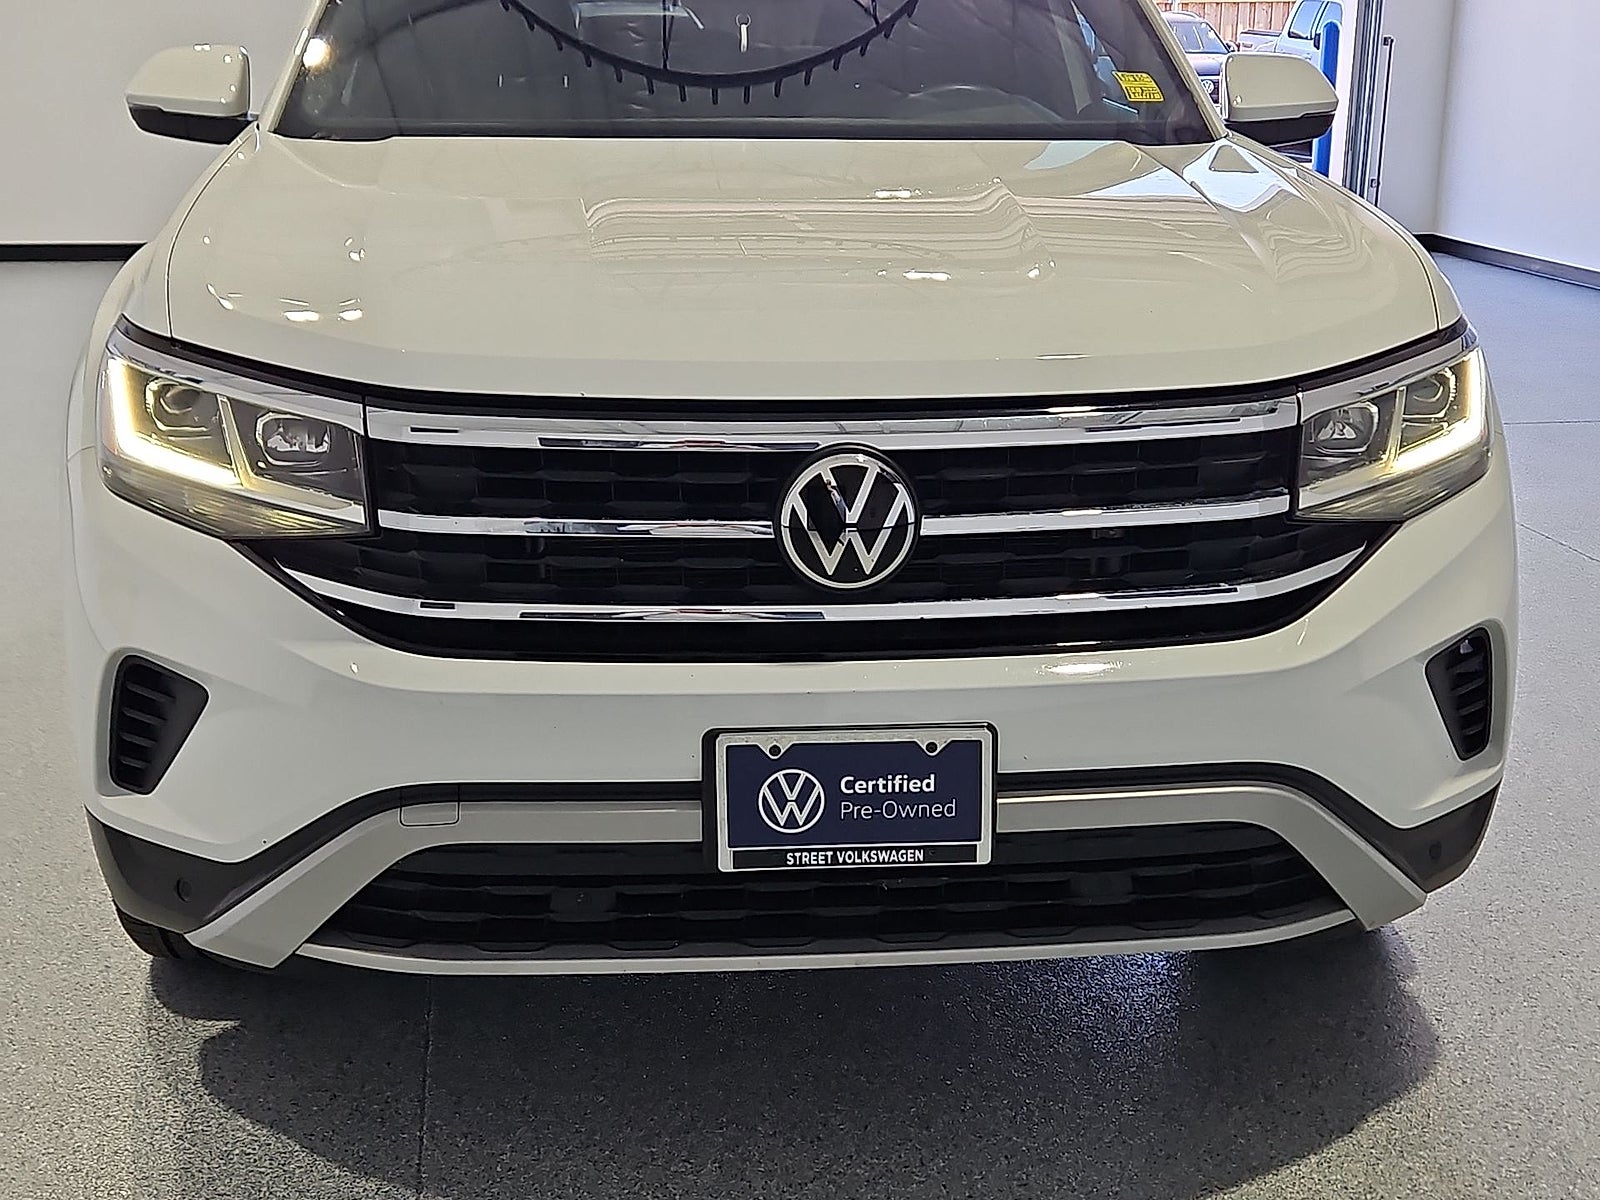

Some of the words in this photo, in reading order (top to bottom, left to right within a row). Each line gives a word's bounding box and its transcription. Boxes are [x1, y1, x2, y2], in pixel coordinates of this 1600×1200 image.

[783, 456, 914, 588] VW
[840, 773, 935, 793] Certified
[759, 769, 825, 833] VW
[840, 798, 956, 819] Pre-Owned
[786, 851, 833, 865] STREET
[836, 849, 924, 863] VOLKSWAGEN
